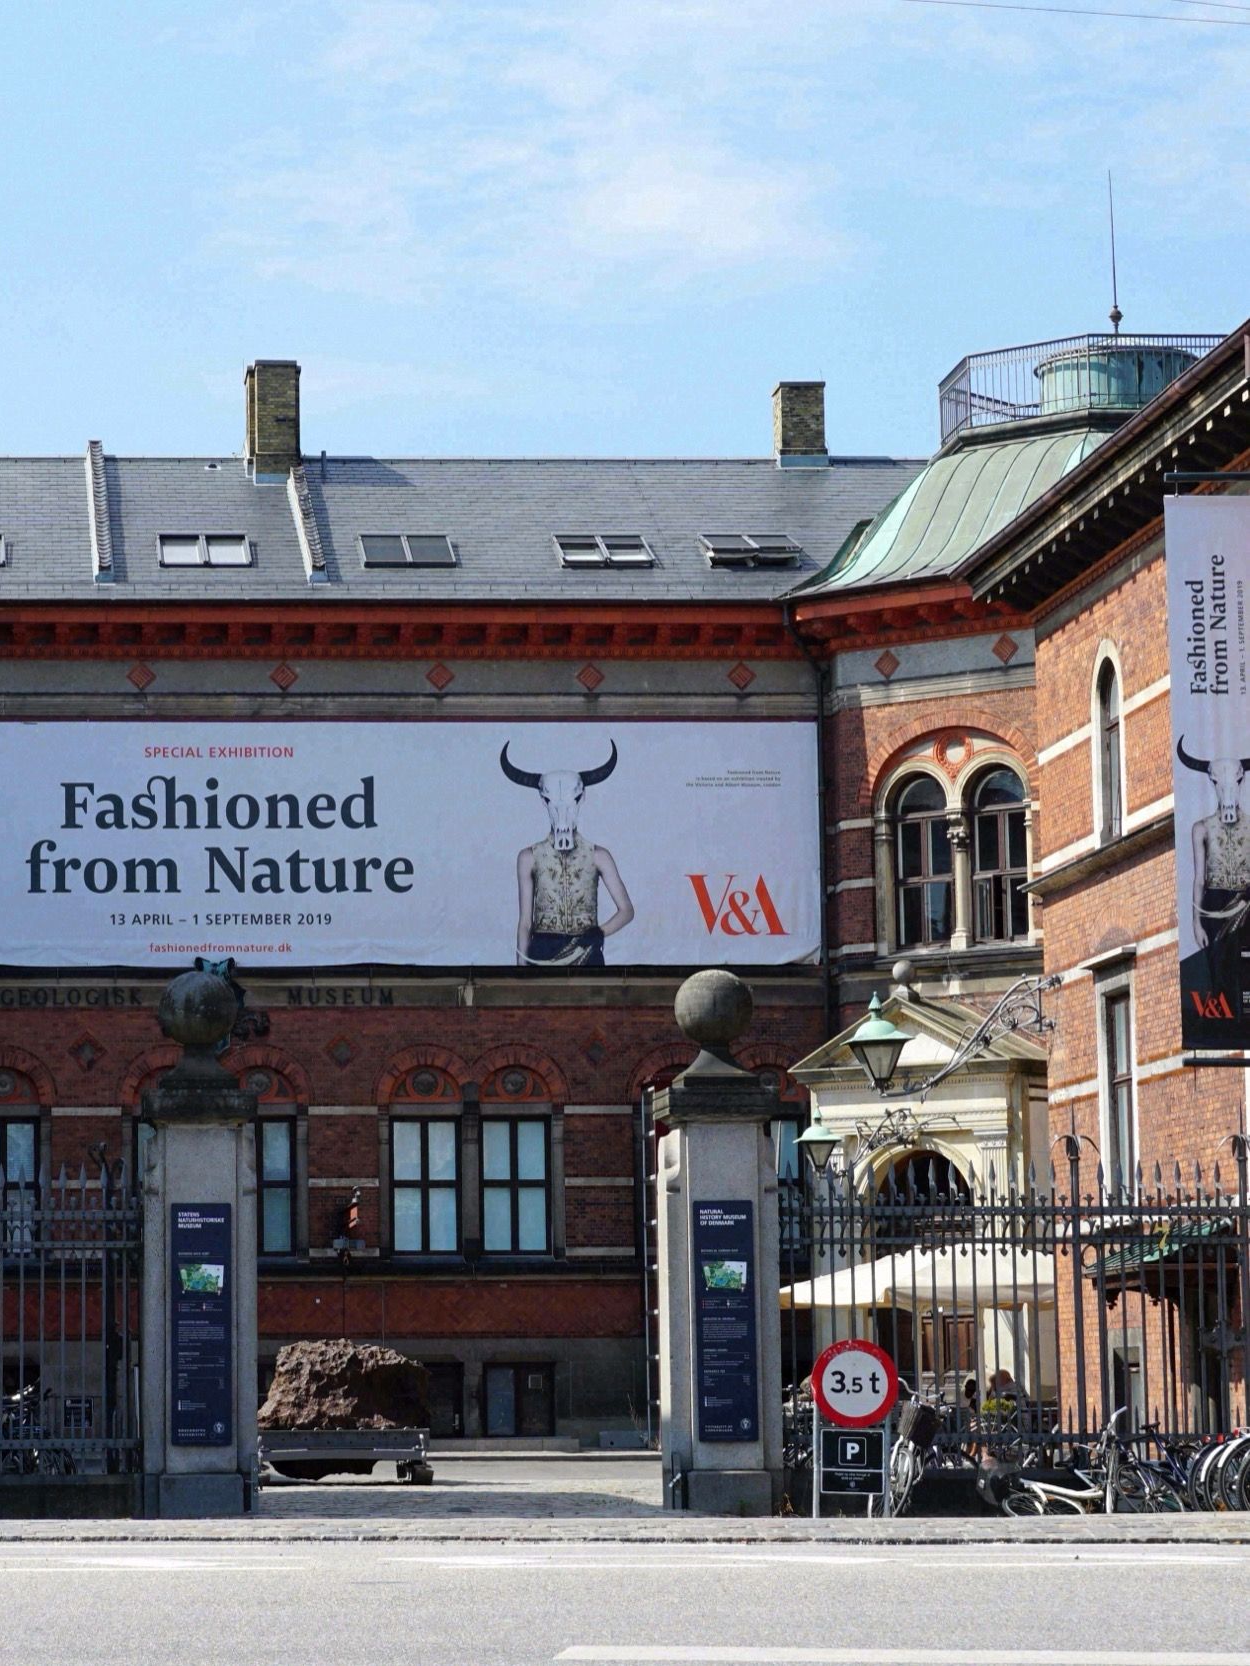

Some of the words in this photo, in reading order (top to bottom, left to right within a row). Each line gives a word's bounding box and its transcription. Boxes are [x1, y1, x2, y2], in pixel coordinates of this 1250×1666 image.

[1209, 554, 1227, 631] Nature
[1185, 579, 1207, 695] Fashioned
[1209, 639, 1229, 696] from
[144, 746, 204, 758] SPECIAL
[209, 746, 294, 758] EXHIBITION
[60, 775, 378, 830] Fashioned
[25, 839, 182, 894] from
[204, 846, 415, 894] Nature
[684, 873, 792, 936] V&A
[110, 913, 126, 926] 13
[131, 913, 174, 926] APRIL
[192, 913, 199, 926] 1
[205, 913, 292, 926] SEPTEMBER
[297, 913, 332, 926] 2019
[149, 942, 293, 954] fashionedfromnature.dk
[0, 988, 144, 1006] GEOLOGISK
[287, 987, 395, 1006] MUSEUM
[1190, 991, 1235, 1019] V&A
[830, 1370, 863, 1395] 3,5
[869, 1371, 880, 1394] t
[846, 1442, 860, 1460] P
